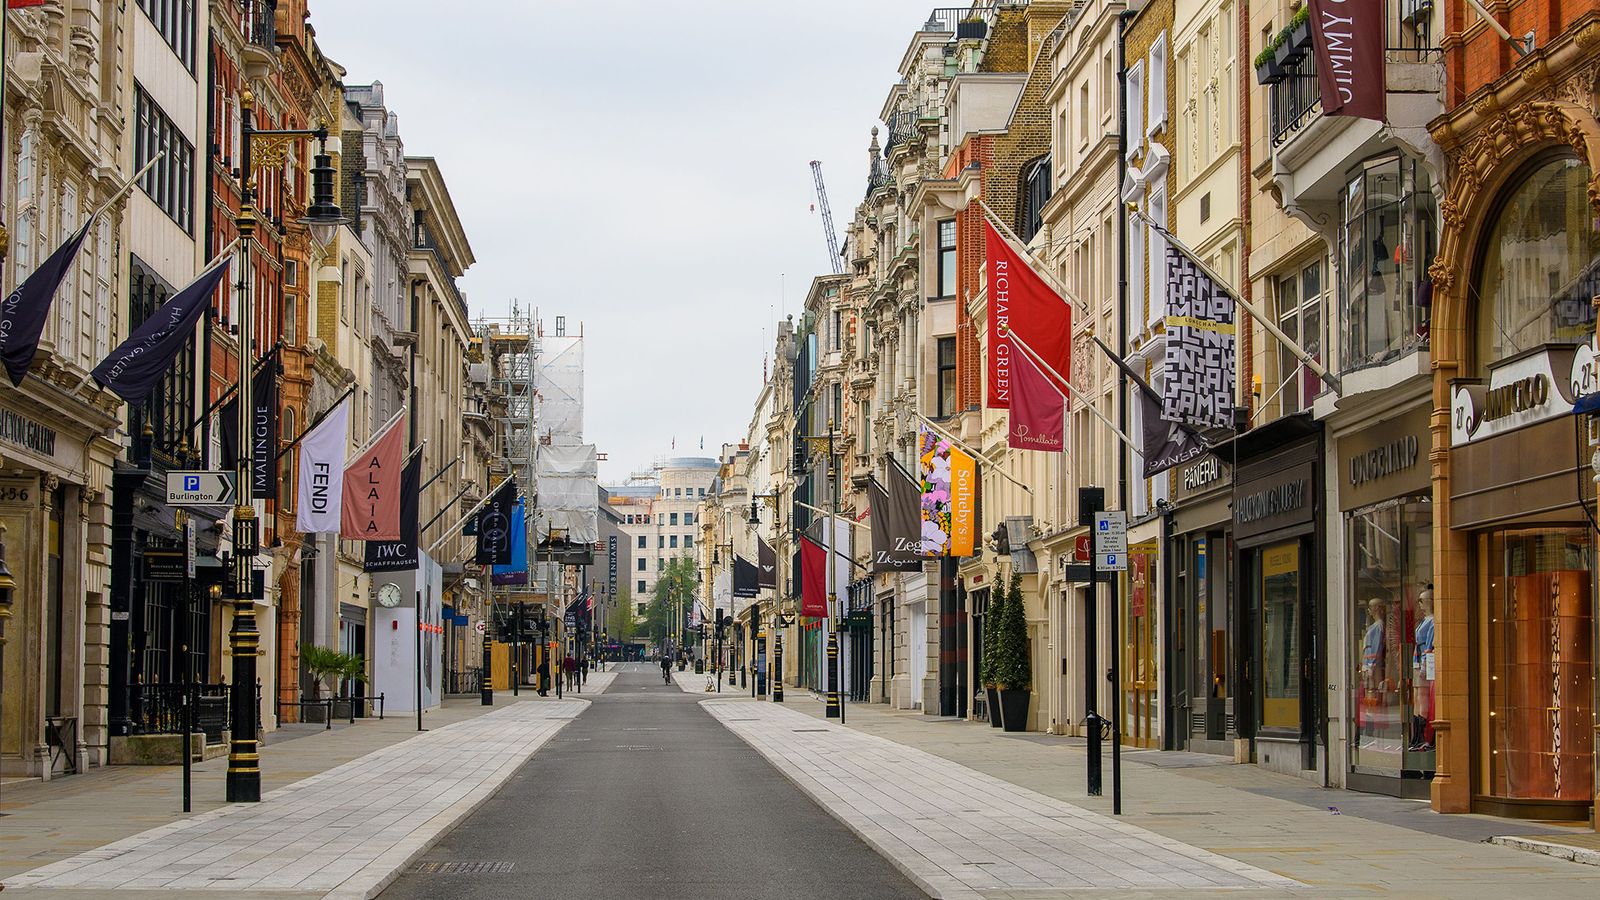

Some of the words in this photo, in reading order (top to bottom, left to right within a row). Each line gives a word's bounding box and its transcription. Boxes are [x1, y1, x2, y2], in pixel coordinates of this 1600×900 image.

[996, 260, 1009, 339] RICHARD
[105, 347, 144, 384] GALLERY
[996, 344, 1009, 401] GREEN
[1012, 423, 1059, 446] Pomellato
[1456, 406, 1464, 430] 27
[256, 405, 268, 487] MALINGUE
[311, 462, 330, 514] FENDI
[1184, 458, 1219, 490] PANERAI
[169, 492, 214, 505] Burlington
[955, 469, 972, 535] Sotheby's
[365, 559, 417, 568] SCHAFFHAUSEN
[377, 543, 409, 559] IWC
